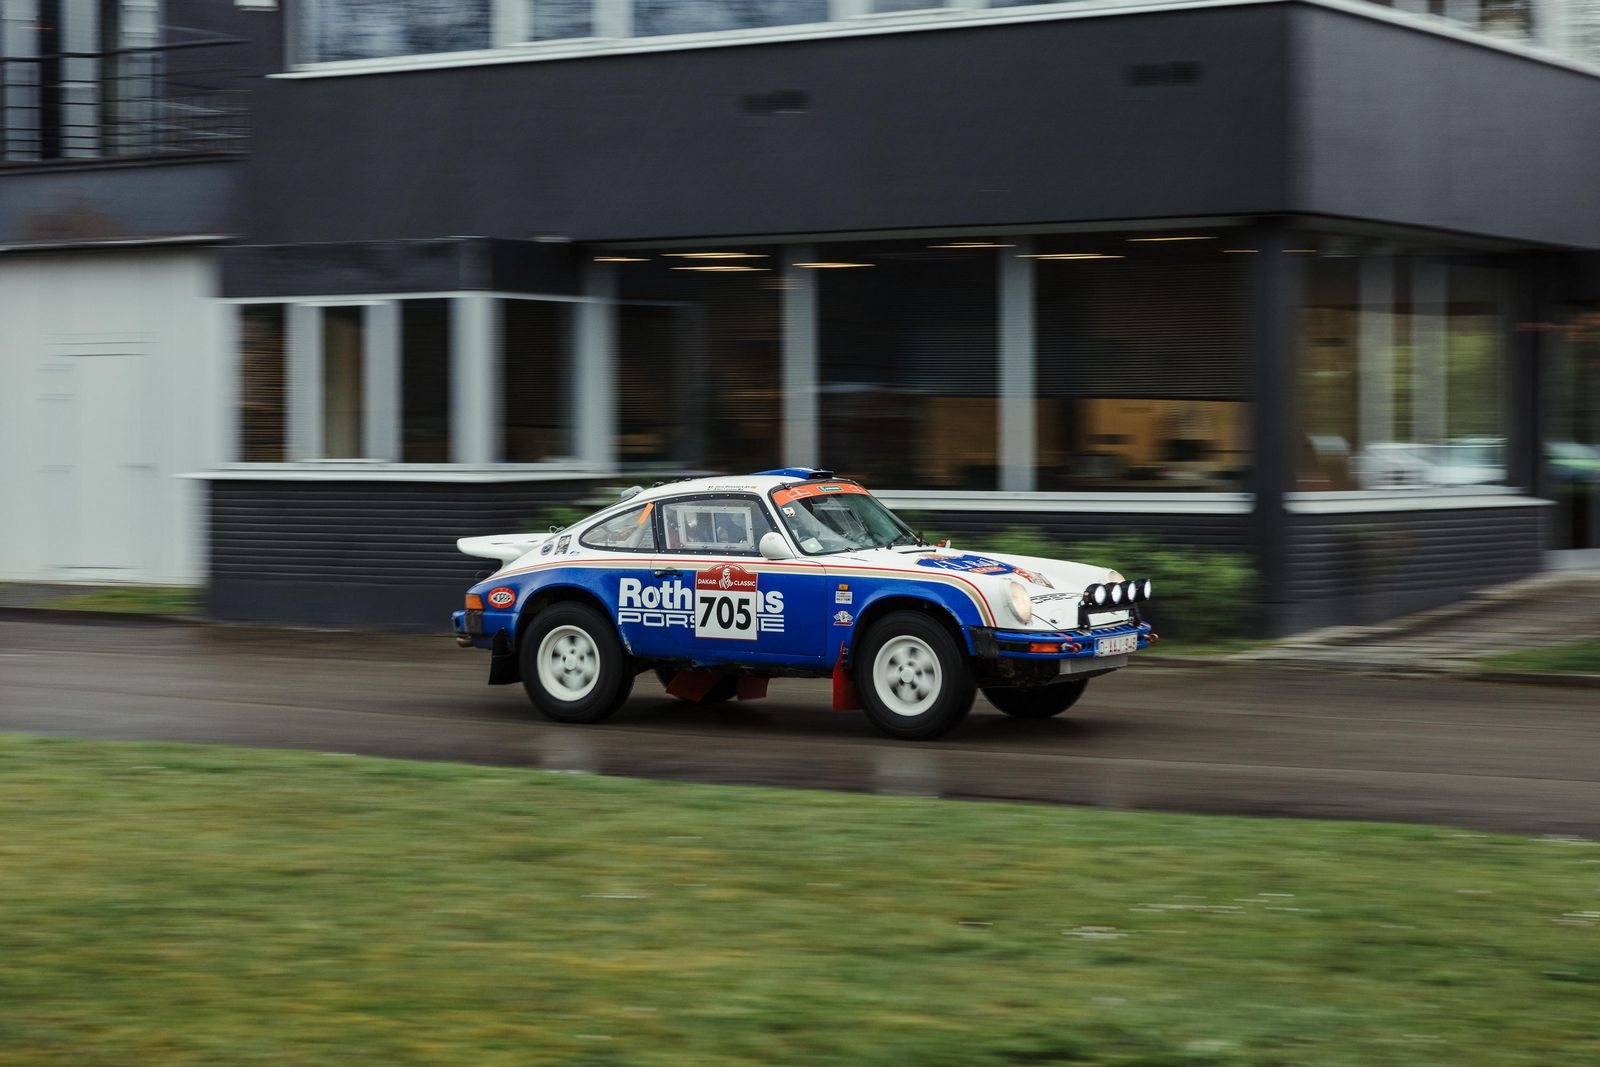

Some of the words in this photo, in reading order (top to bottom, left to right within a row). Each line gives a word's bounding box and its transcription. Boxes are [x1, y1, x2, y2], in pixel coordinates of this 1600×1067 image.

[618, 577, 785, 614] Roths
[617, 611, 785, 633] PORE
[699, 596, 752, 631] 705
